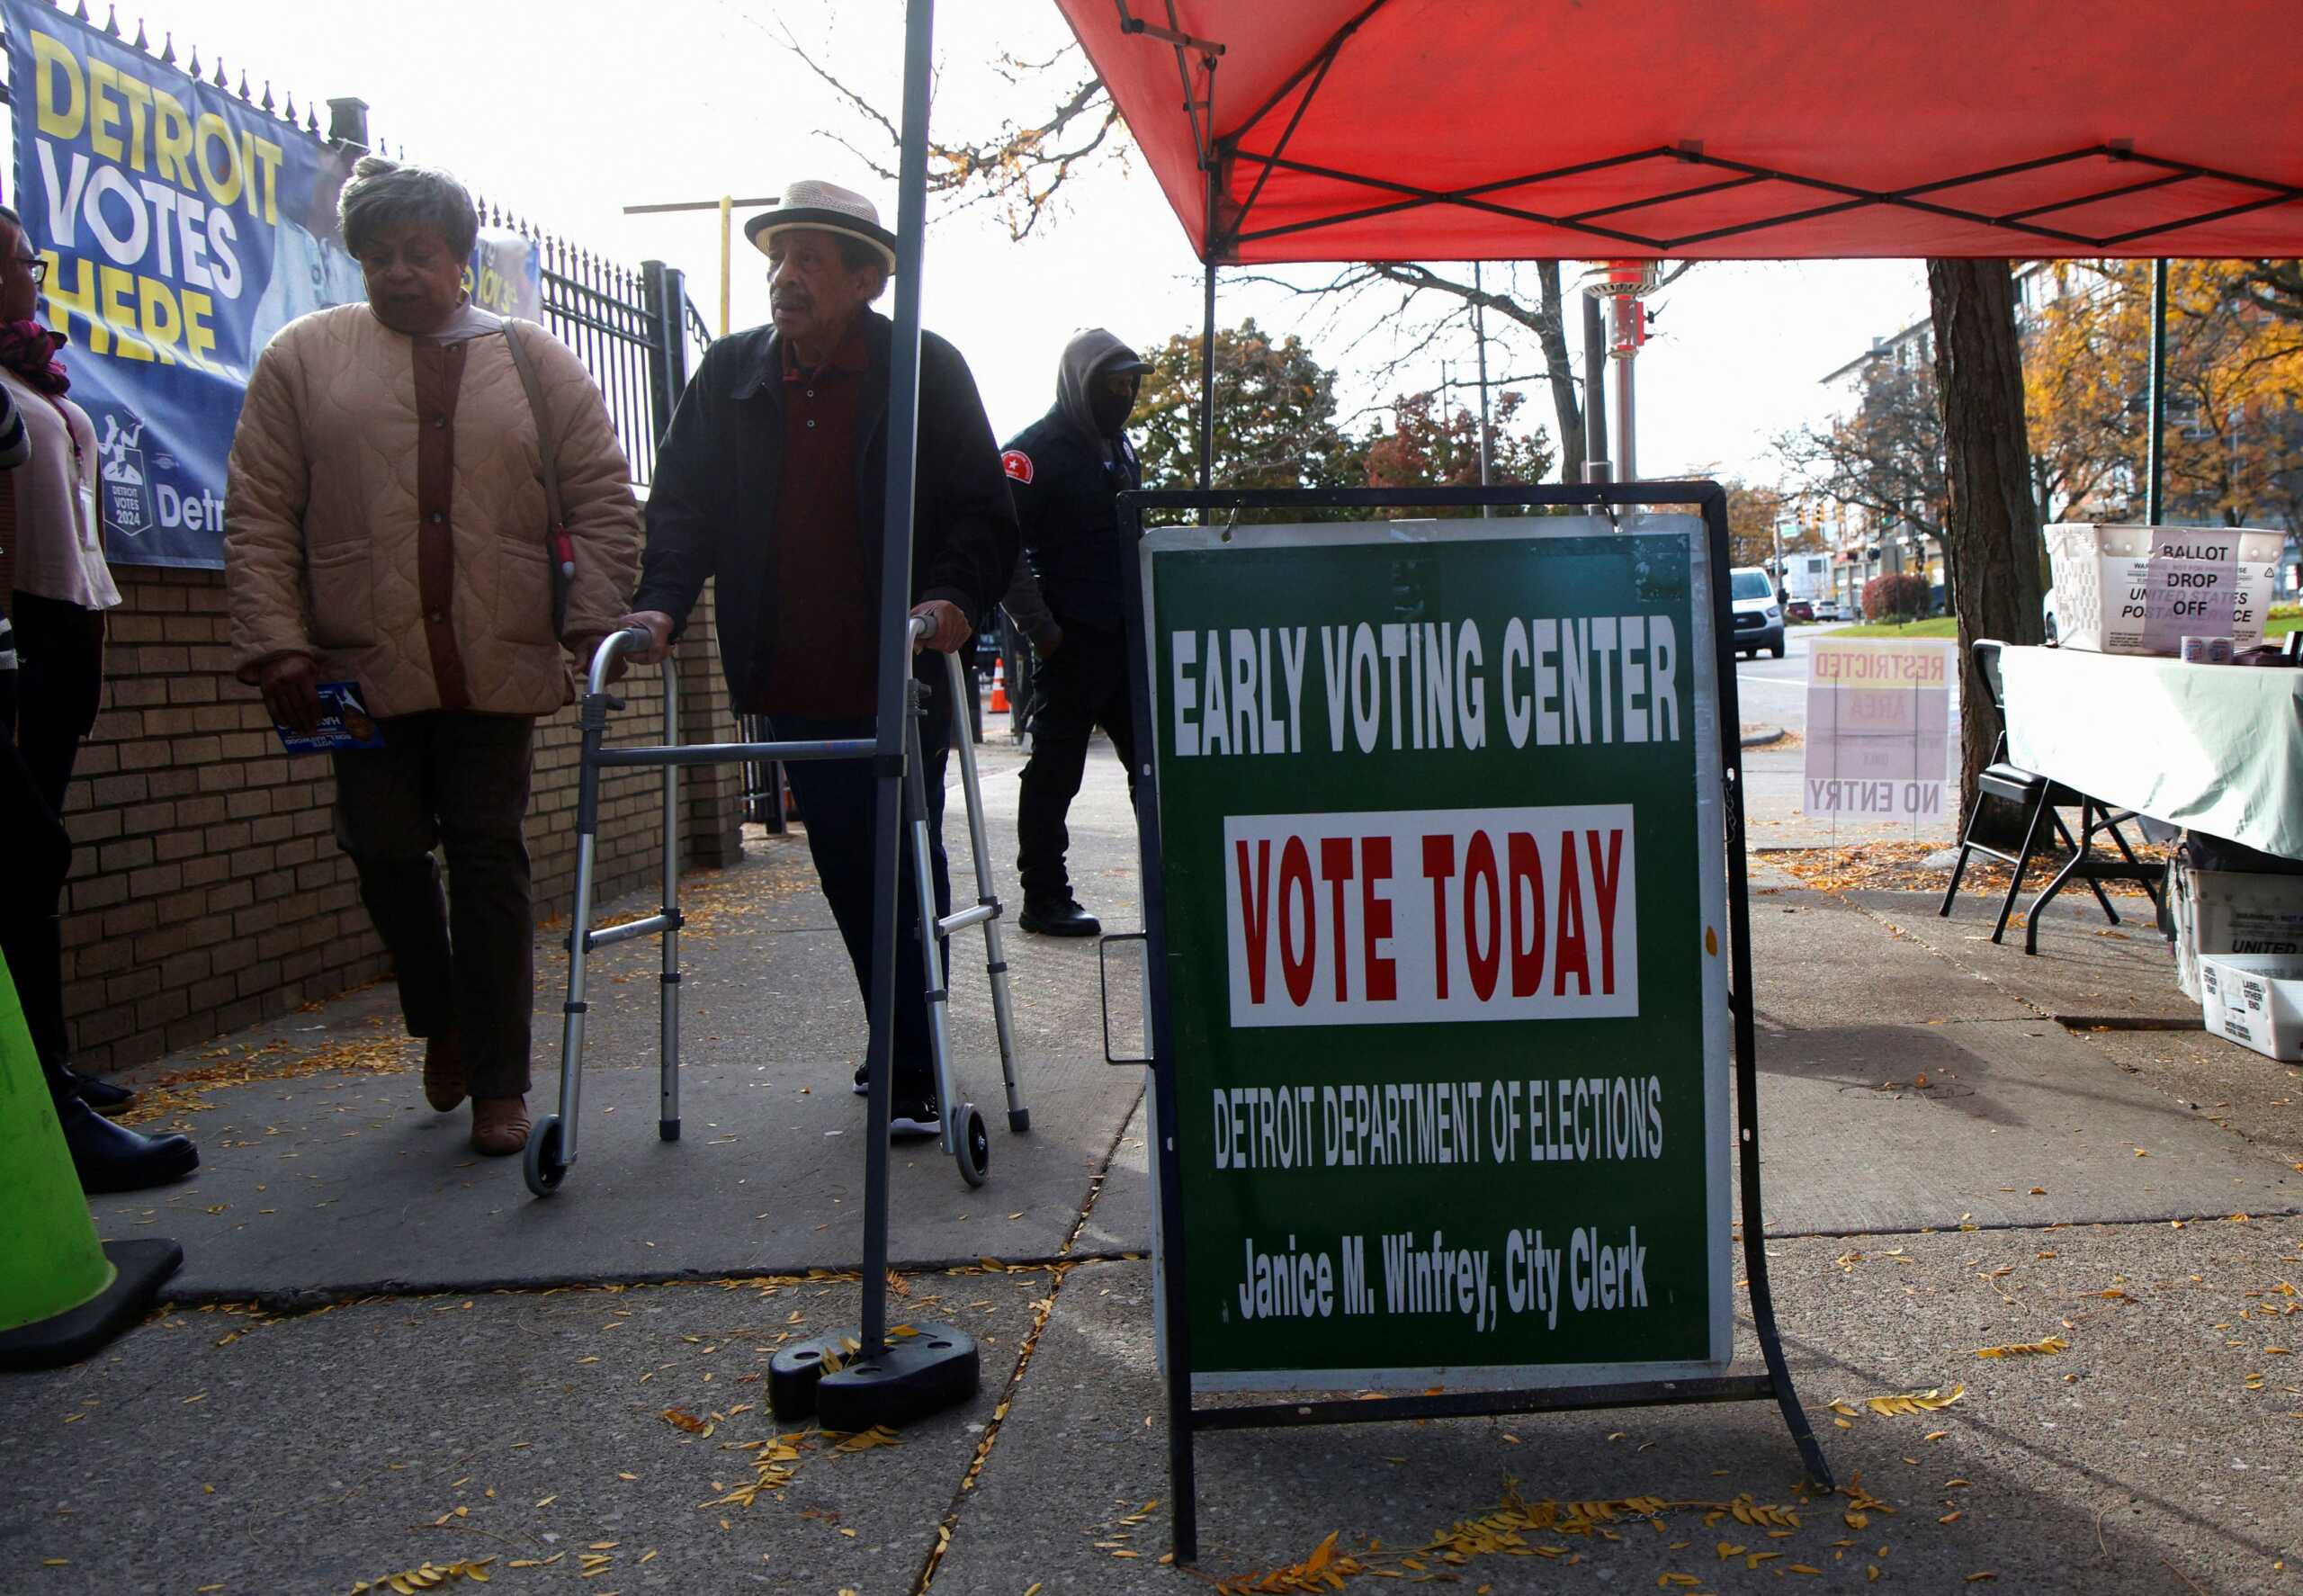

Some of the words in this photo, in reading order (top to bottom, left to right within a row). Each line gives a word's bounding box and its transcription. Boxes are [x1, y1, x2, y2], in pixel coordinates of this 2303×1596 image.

[30, 29, 282, 227] DETROIT
[35, 138, 242, 300] VOTES
[114, 496, 139, 511] VOTES
[156, 483, 225, 532] Detr
[116, 509, 141, 526] 2024
[2163, 545, 2229, 561] BALLOT
[2167, 572, 2218, 587] DROP
[2130, 587, 2186, 602] UNITED
[2189, 590, 2248, 605] STATES
[2121, 605, 2182, 620] POSTAL
[2173, 600, 2208, 615] OFF
[1171, 626, 1307, 757] EARLY
[1321, 618, 1486, 754] VOTING
[1502, 614, 1680, 749] CENTER
[1236, 835, 1397, 1007] VOTE
[1421, 829, 1624, 1001] TODAY
[2232, 938, 2297, 954] UNITED
[1214, 1085, 1315, 1170] DETROIT
[1323, 1081, 1482, 1167] DEPARTMENT
[1491, 1080, 1520, 1163] OF
[1529, 1075, 1662, 1161] ELECTIONS
[1239, 1234, 1333, 1319] Janice
[1342, 1235, 1375, 1314] M.
[1382, 1230, 1497, 1332] Winfrey,
[1506, 1228, 1561, 1331] City
[1571, 1225, 1648, 1312] Clerk
